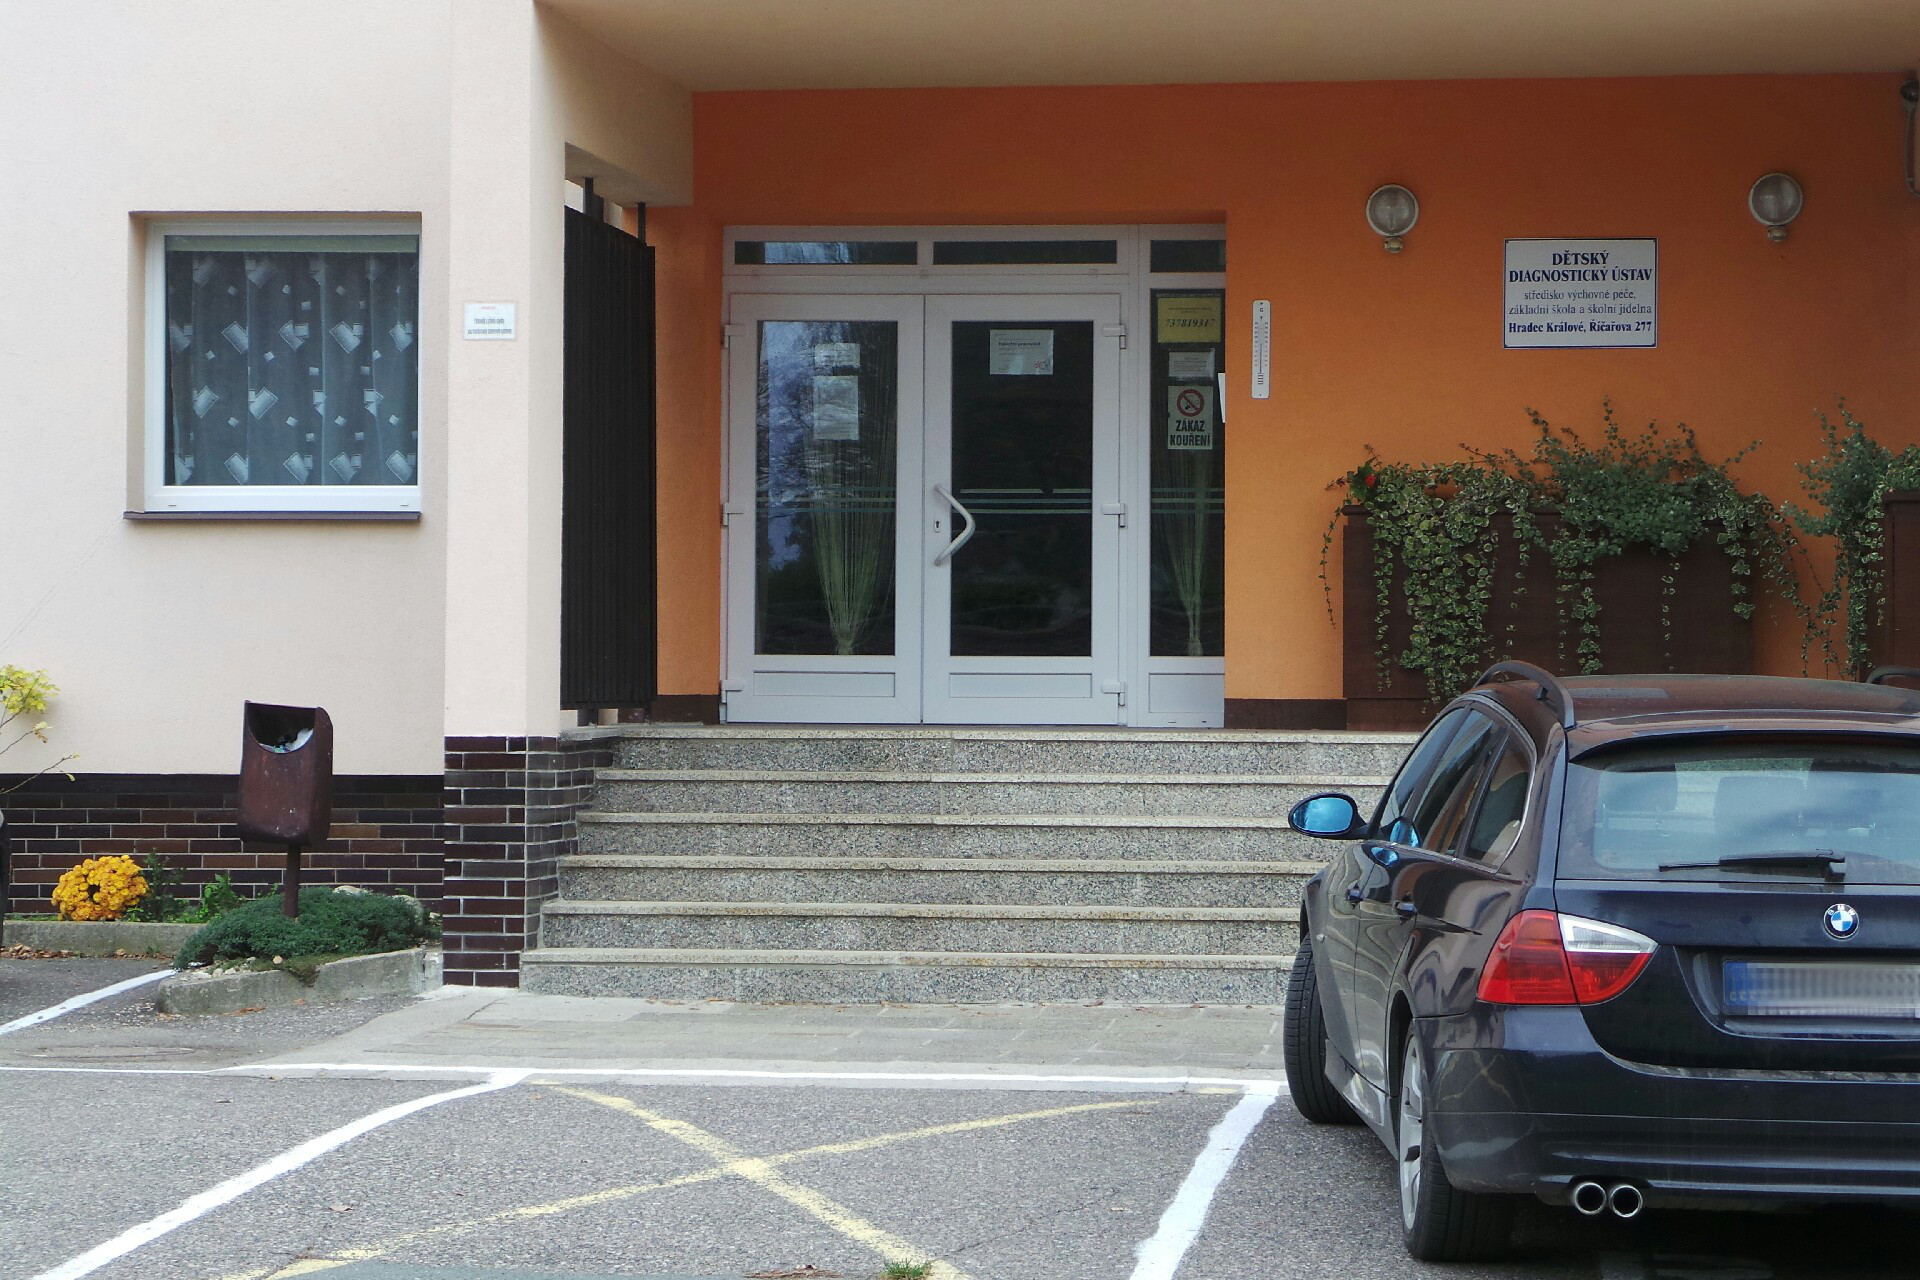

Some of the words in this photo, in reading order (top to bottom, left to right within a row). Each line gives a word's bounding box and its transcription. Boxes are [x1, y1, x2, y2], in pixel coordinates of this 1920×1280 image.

[1552, 250, 1609, 265] DĚTSKÝ
[1509, 266, 1608, 282] DIAGNOSTICKÝ
[1612, 265, 1652, 281] ÚSTAV
[1524, 289, 1564, 300] středisko
[1508, 304, 1549, 315] základní
[1552, 304, 1576, 314] škola
[1588, 303, 1616, 314] školní
[1618, 303, 1652, 316] jídelna
[1508, 322, 1544, 333] Hradec
[1546, 321, 1587, 333] Králové,
[1634, 321, 1652, 332] 277
[1175, 418, 1205, 432] ZÁKAZ
[1169, 433, 1212, 446] KOUŘENÍ
